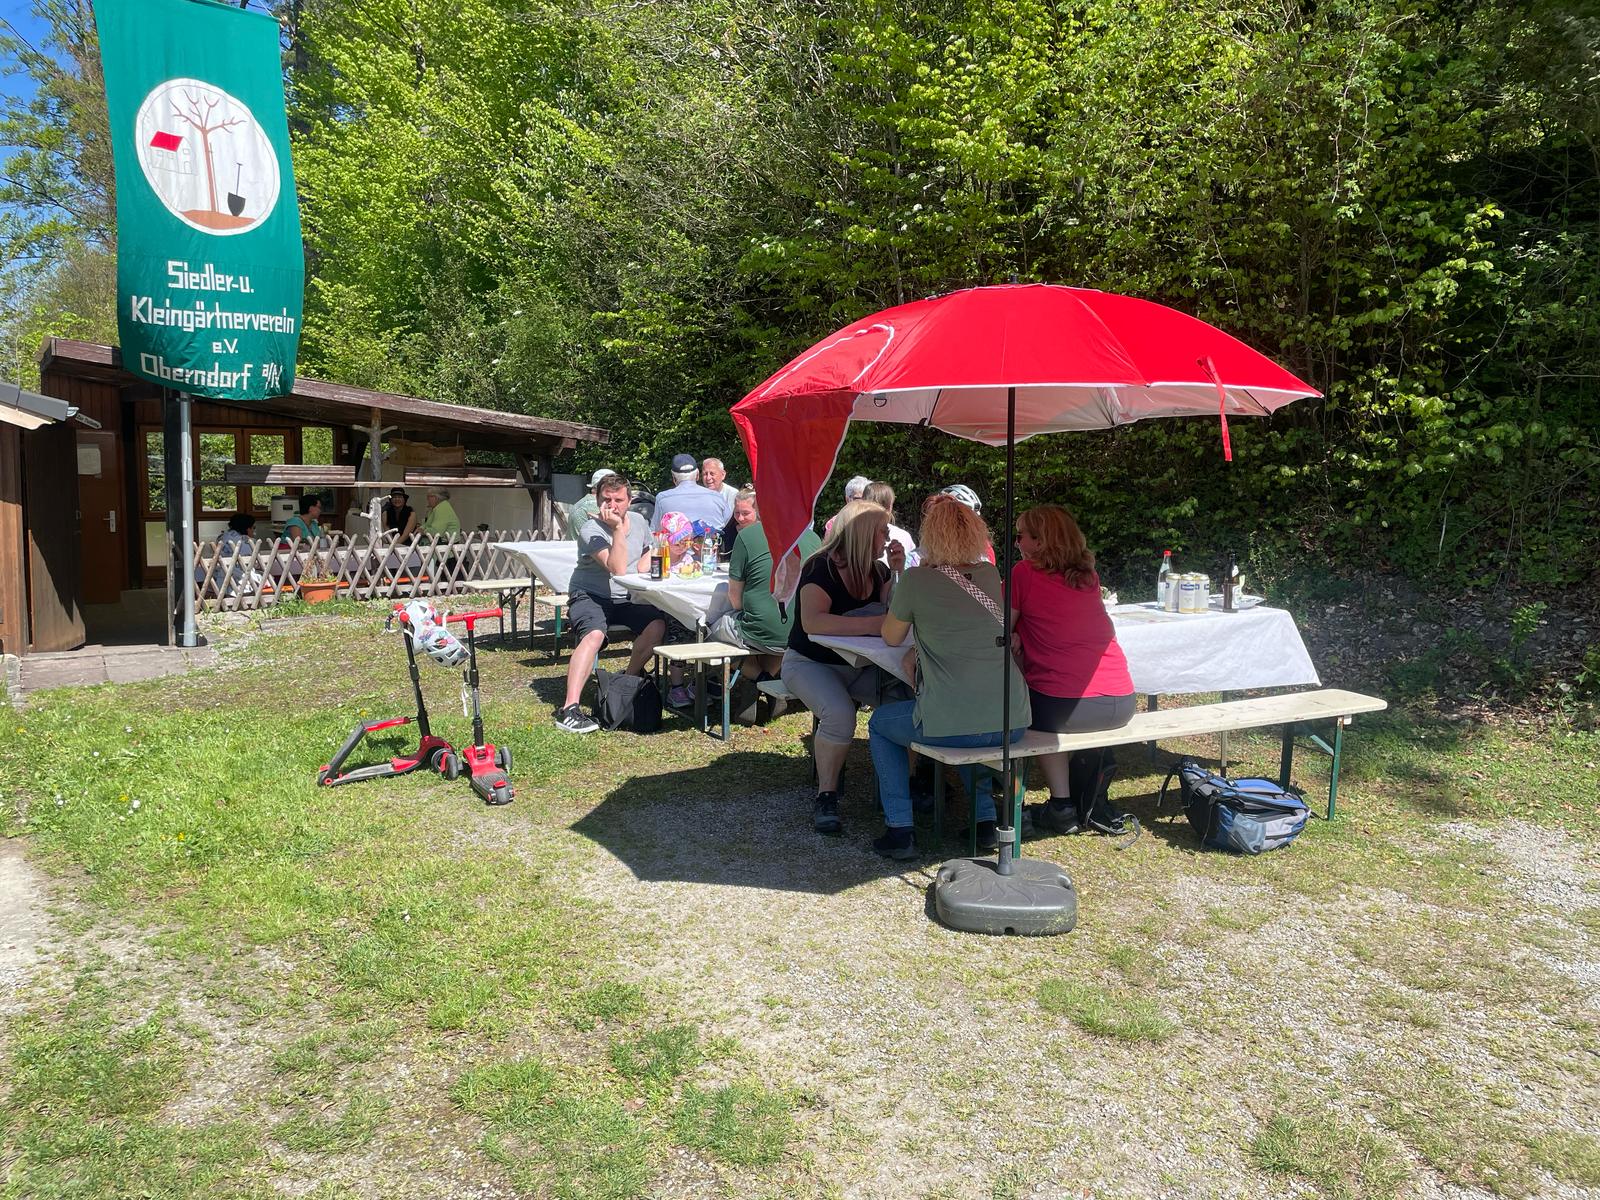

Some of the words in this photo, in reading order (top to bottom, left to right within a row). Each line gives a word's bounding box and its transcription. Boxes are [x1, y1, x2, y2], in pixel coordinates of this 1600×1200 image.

[131, 295, 294, 334] Kleingärtnerverein
[212, 338, 239, 354] e.V.
[140, 352, 253, 390] Oberndorf
